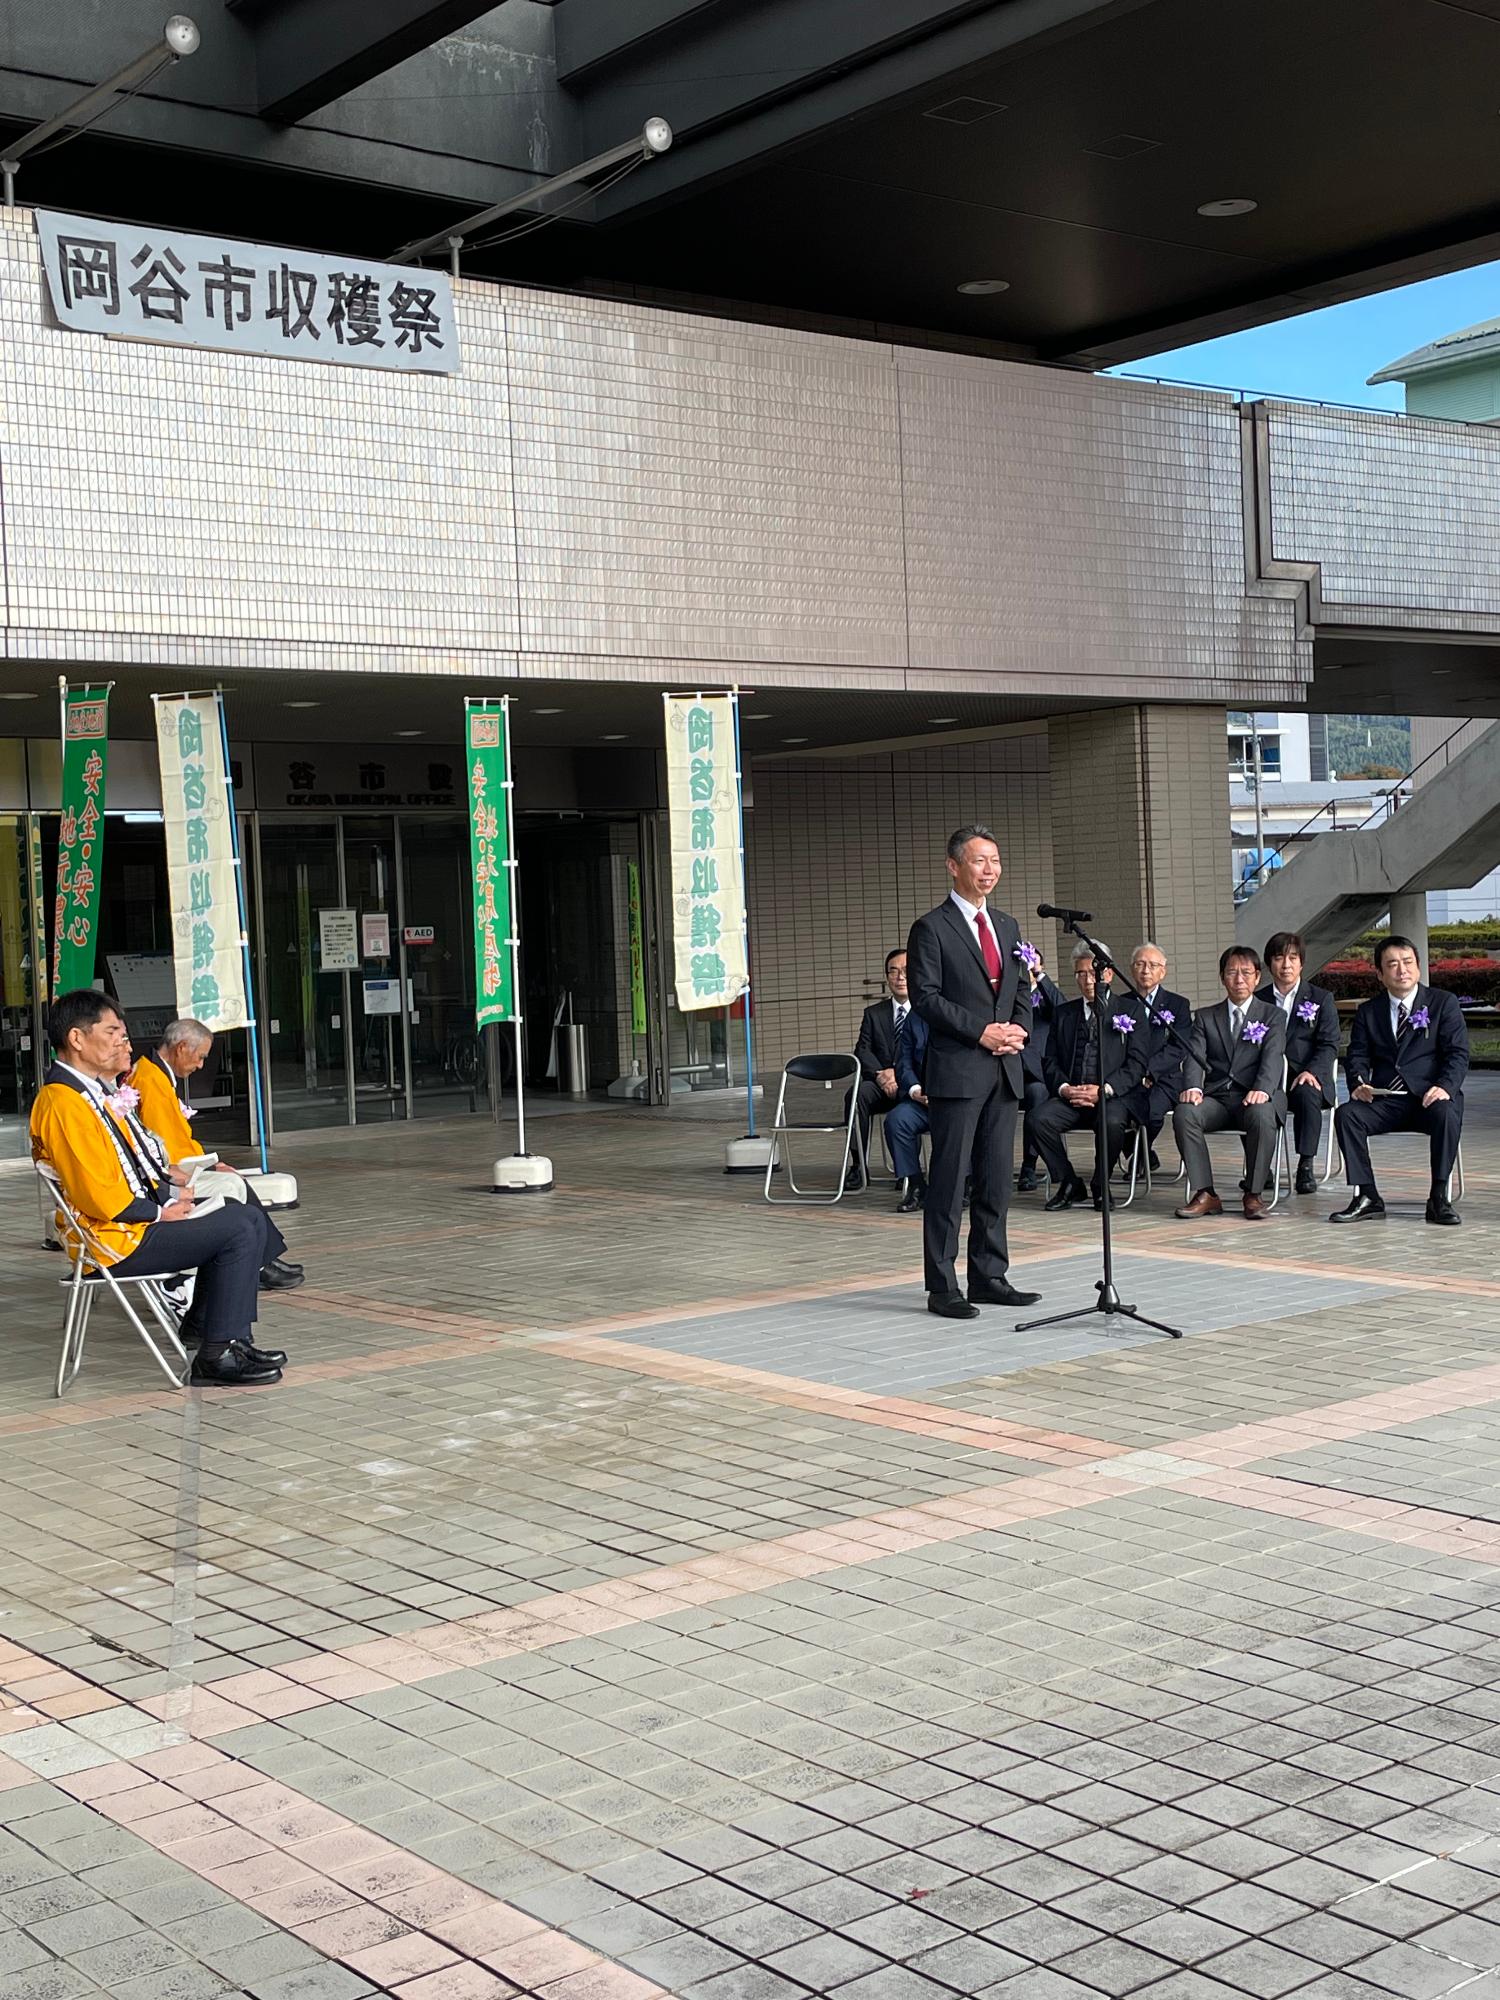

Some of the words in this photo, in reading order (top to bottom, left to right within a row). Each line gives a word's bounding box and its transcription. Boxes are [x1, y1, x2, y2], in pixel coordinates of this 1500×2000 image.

[57, 234, 446, 353] 岡谷市収穫祭
[414, 928, 433, 937] AED
